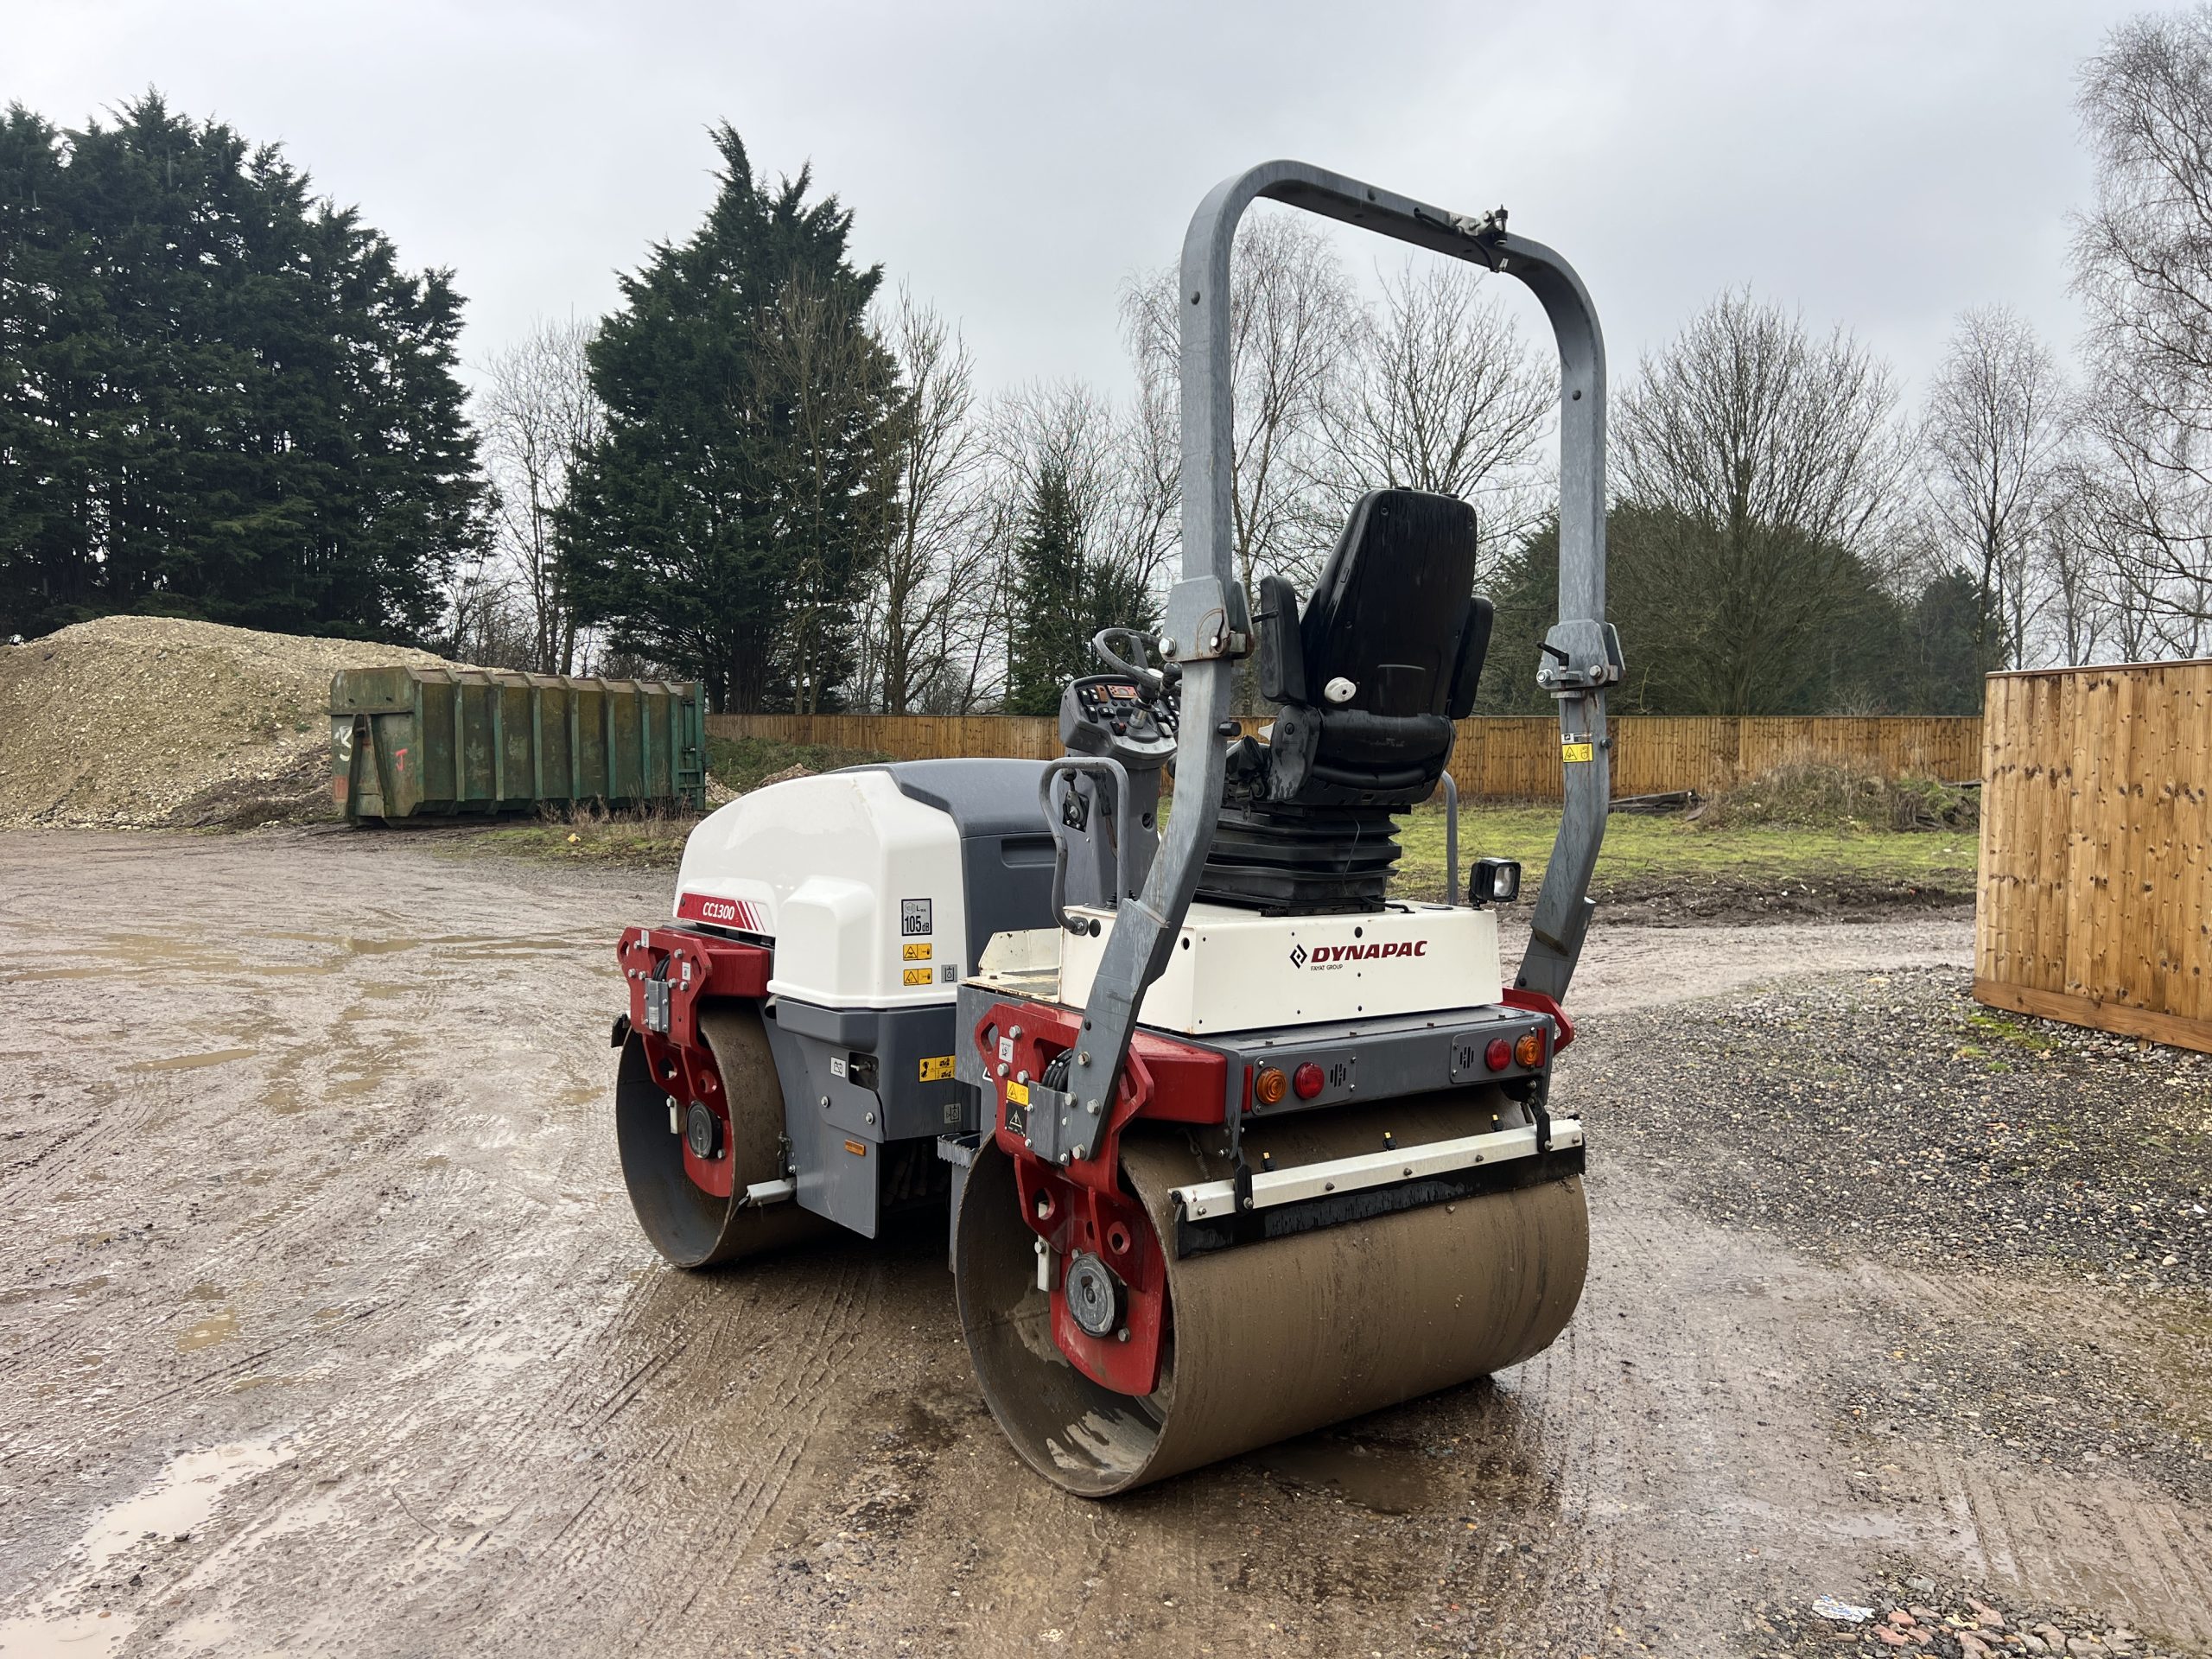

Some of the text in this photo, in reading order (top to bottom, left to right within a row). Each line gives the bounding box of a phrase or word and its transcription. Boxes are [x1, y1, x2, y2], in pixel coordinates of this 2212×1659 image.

[702, 902, 734, 920] CC1300
[905, 915, 930, 932] 105 dB
[1311, 940, 1427, 963] DYNAPAC
